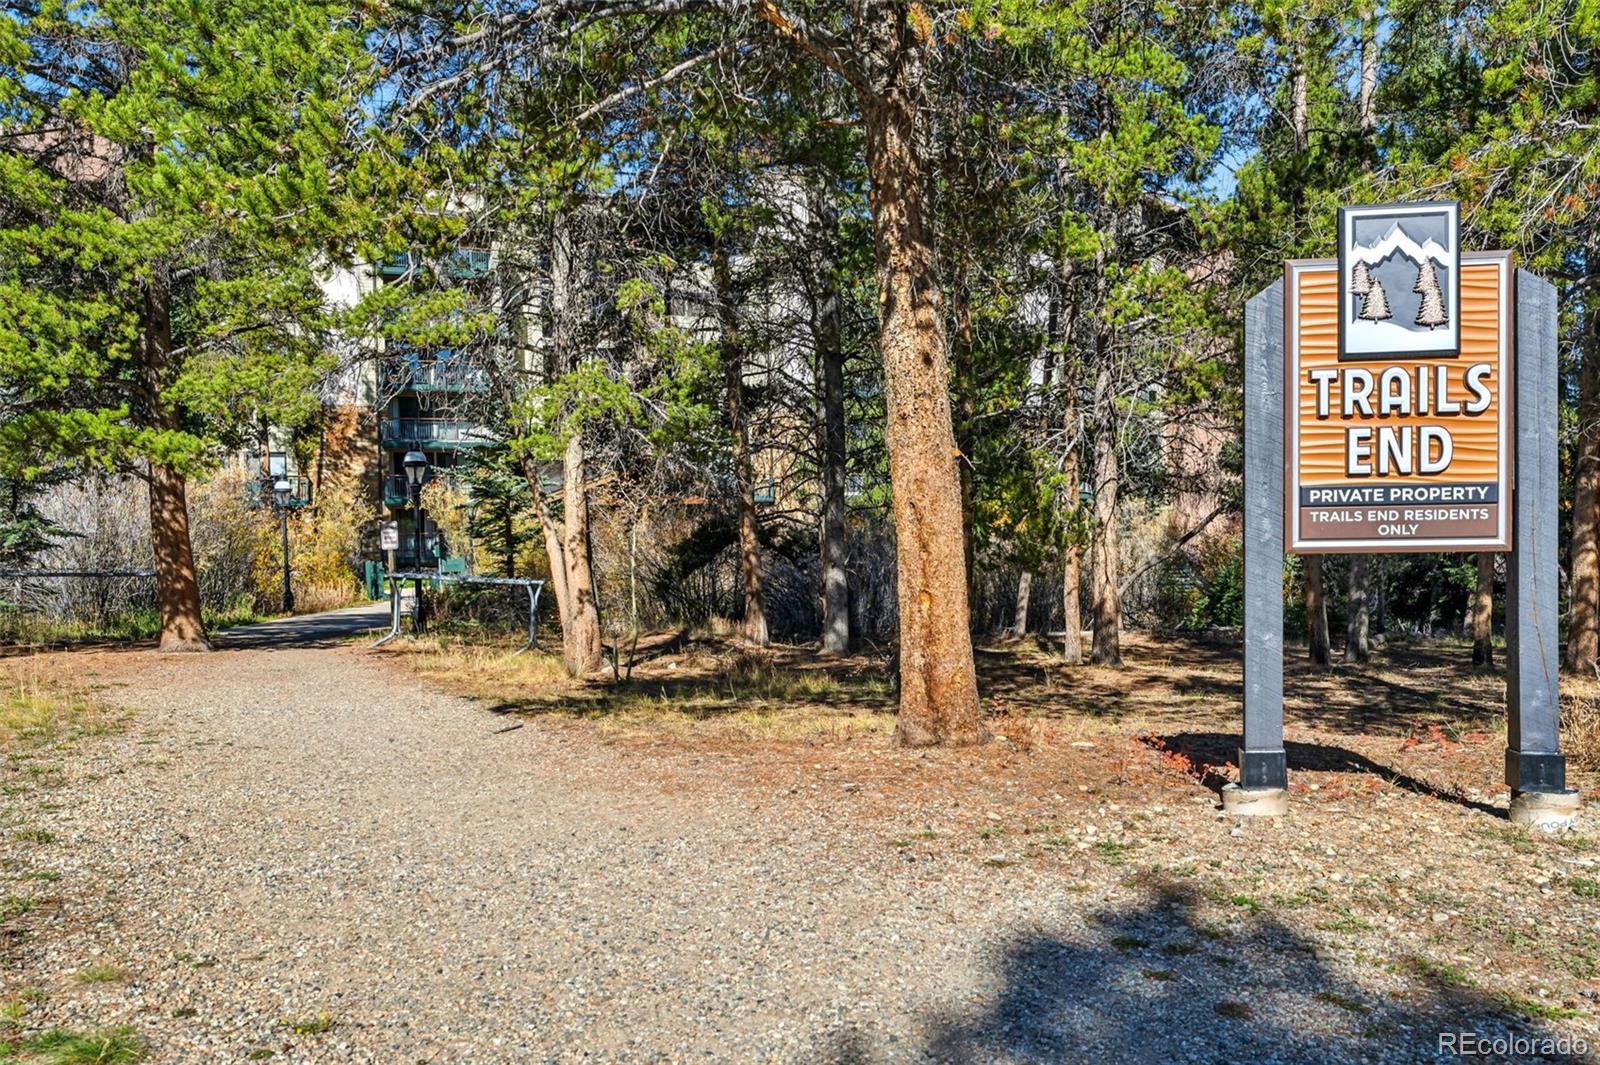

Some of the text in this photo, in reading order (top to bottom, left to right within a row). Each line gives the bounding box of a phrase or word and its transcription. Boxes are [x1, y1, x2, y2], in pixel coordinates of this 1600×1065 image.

[1308, 363, 1492, 419] TRAILS
[1346, 425, 1453, 478] END
[1309, 486, 1490, 503] PRIVATE PROPERTY
[1310, 508, 1490, 523] TRAILS END RESIDENTS
[1377, 524, 1420, 536] ONLY
